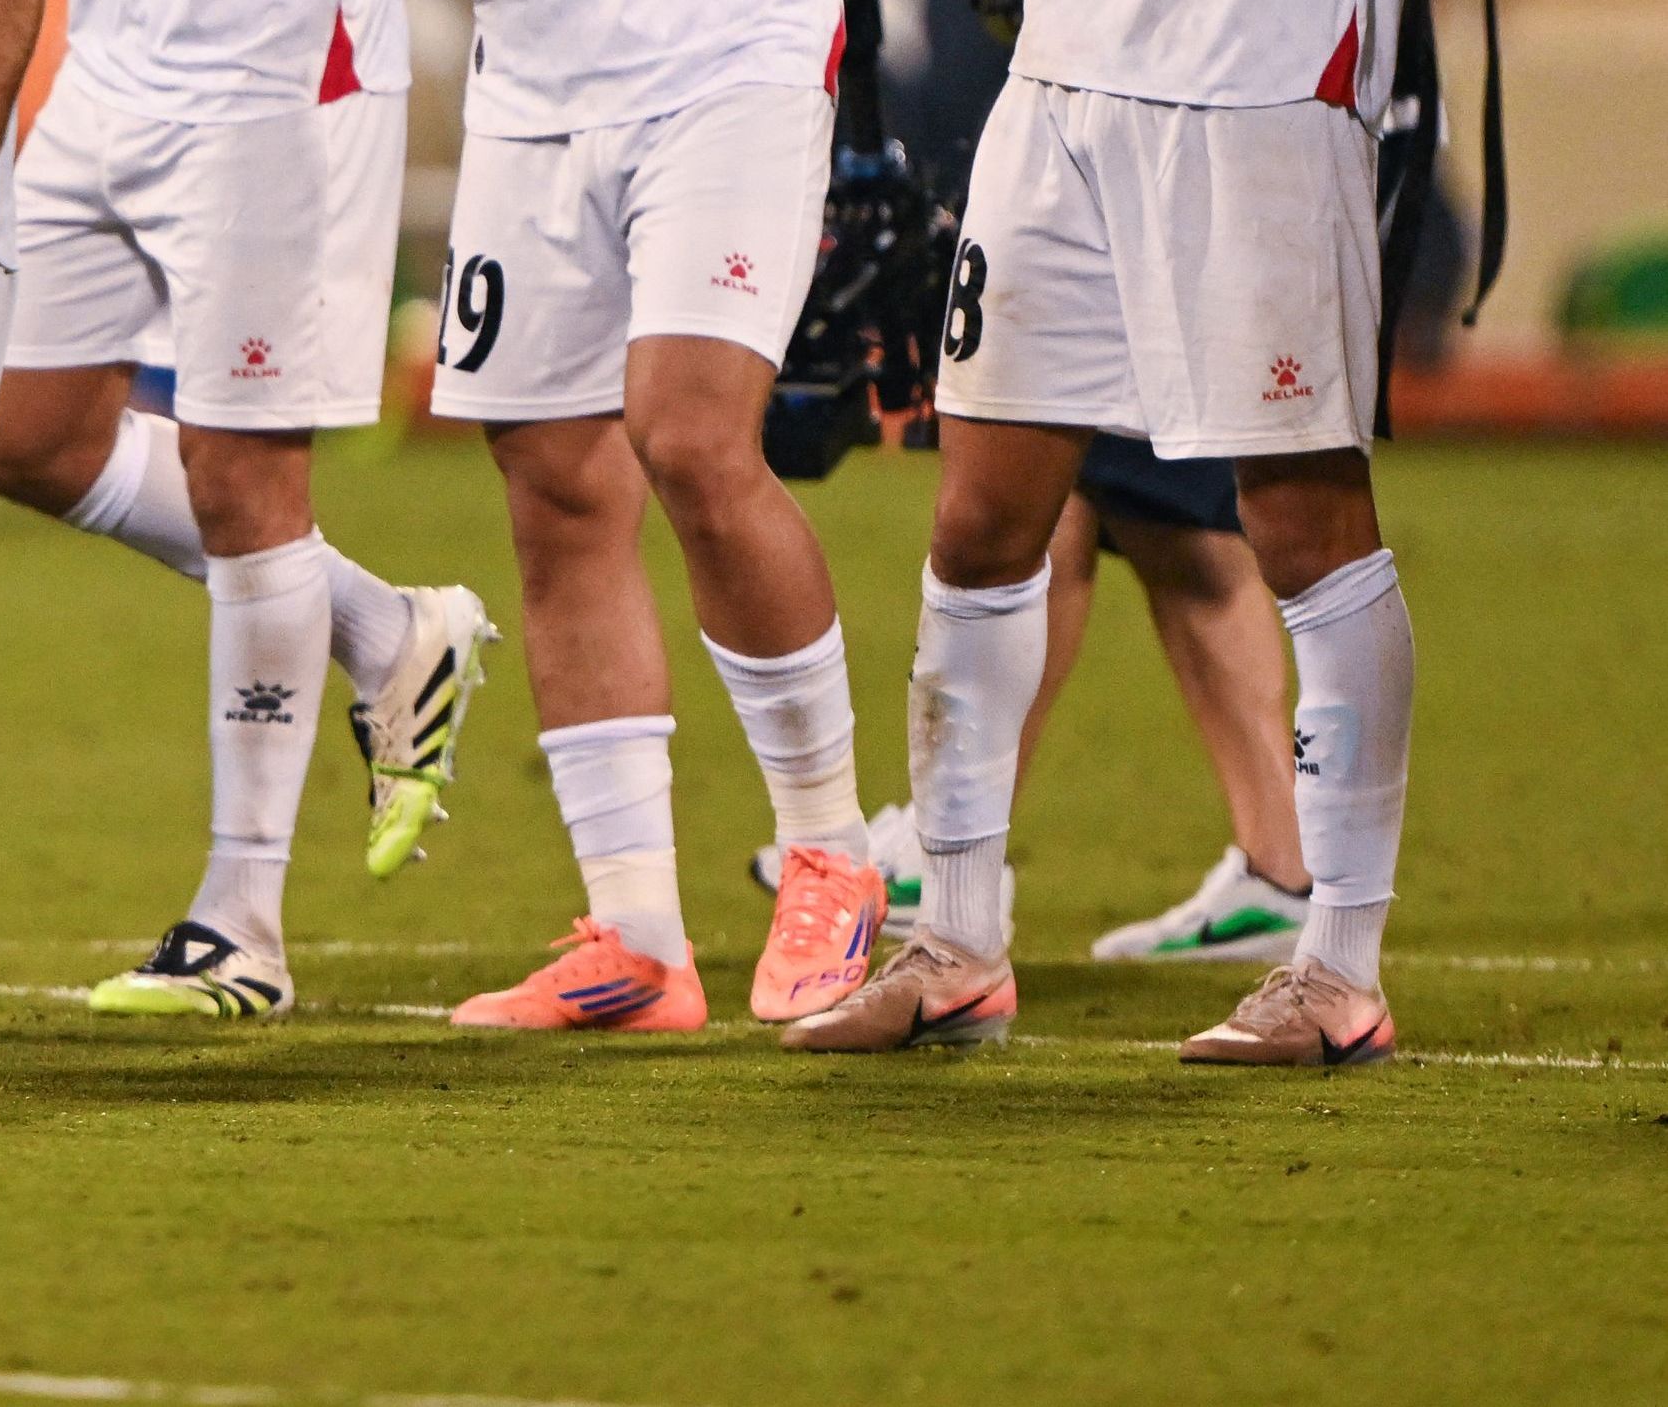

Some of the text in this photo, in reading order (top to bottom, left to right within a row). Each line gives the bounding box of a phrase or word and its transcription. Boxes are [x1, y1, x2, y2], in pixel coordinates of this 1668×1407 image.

[710, 276, 759, 296] KELME
[944, 238, 987, 363] 8
[230, 368, 281, 379] KELME
[1262, 386, 1314, 401] KELME
[225, 710, 294, 724] KELME
